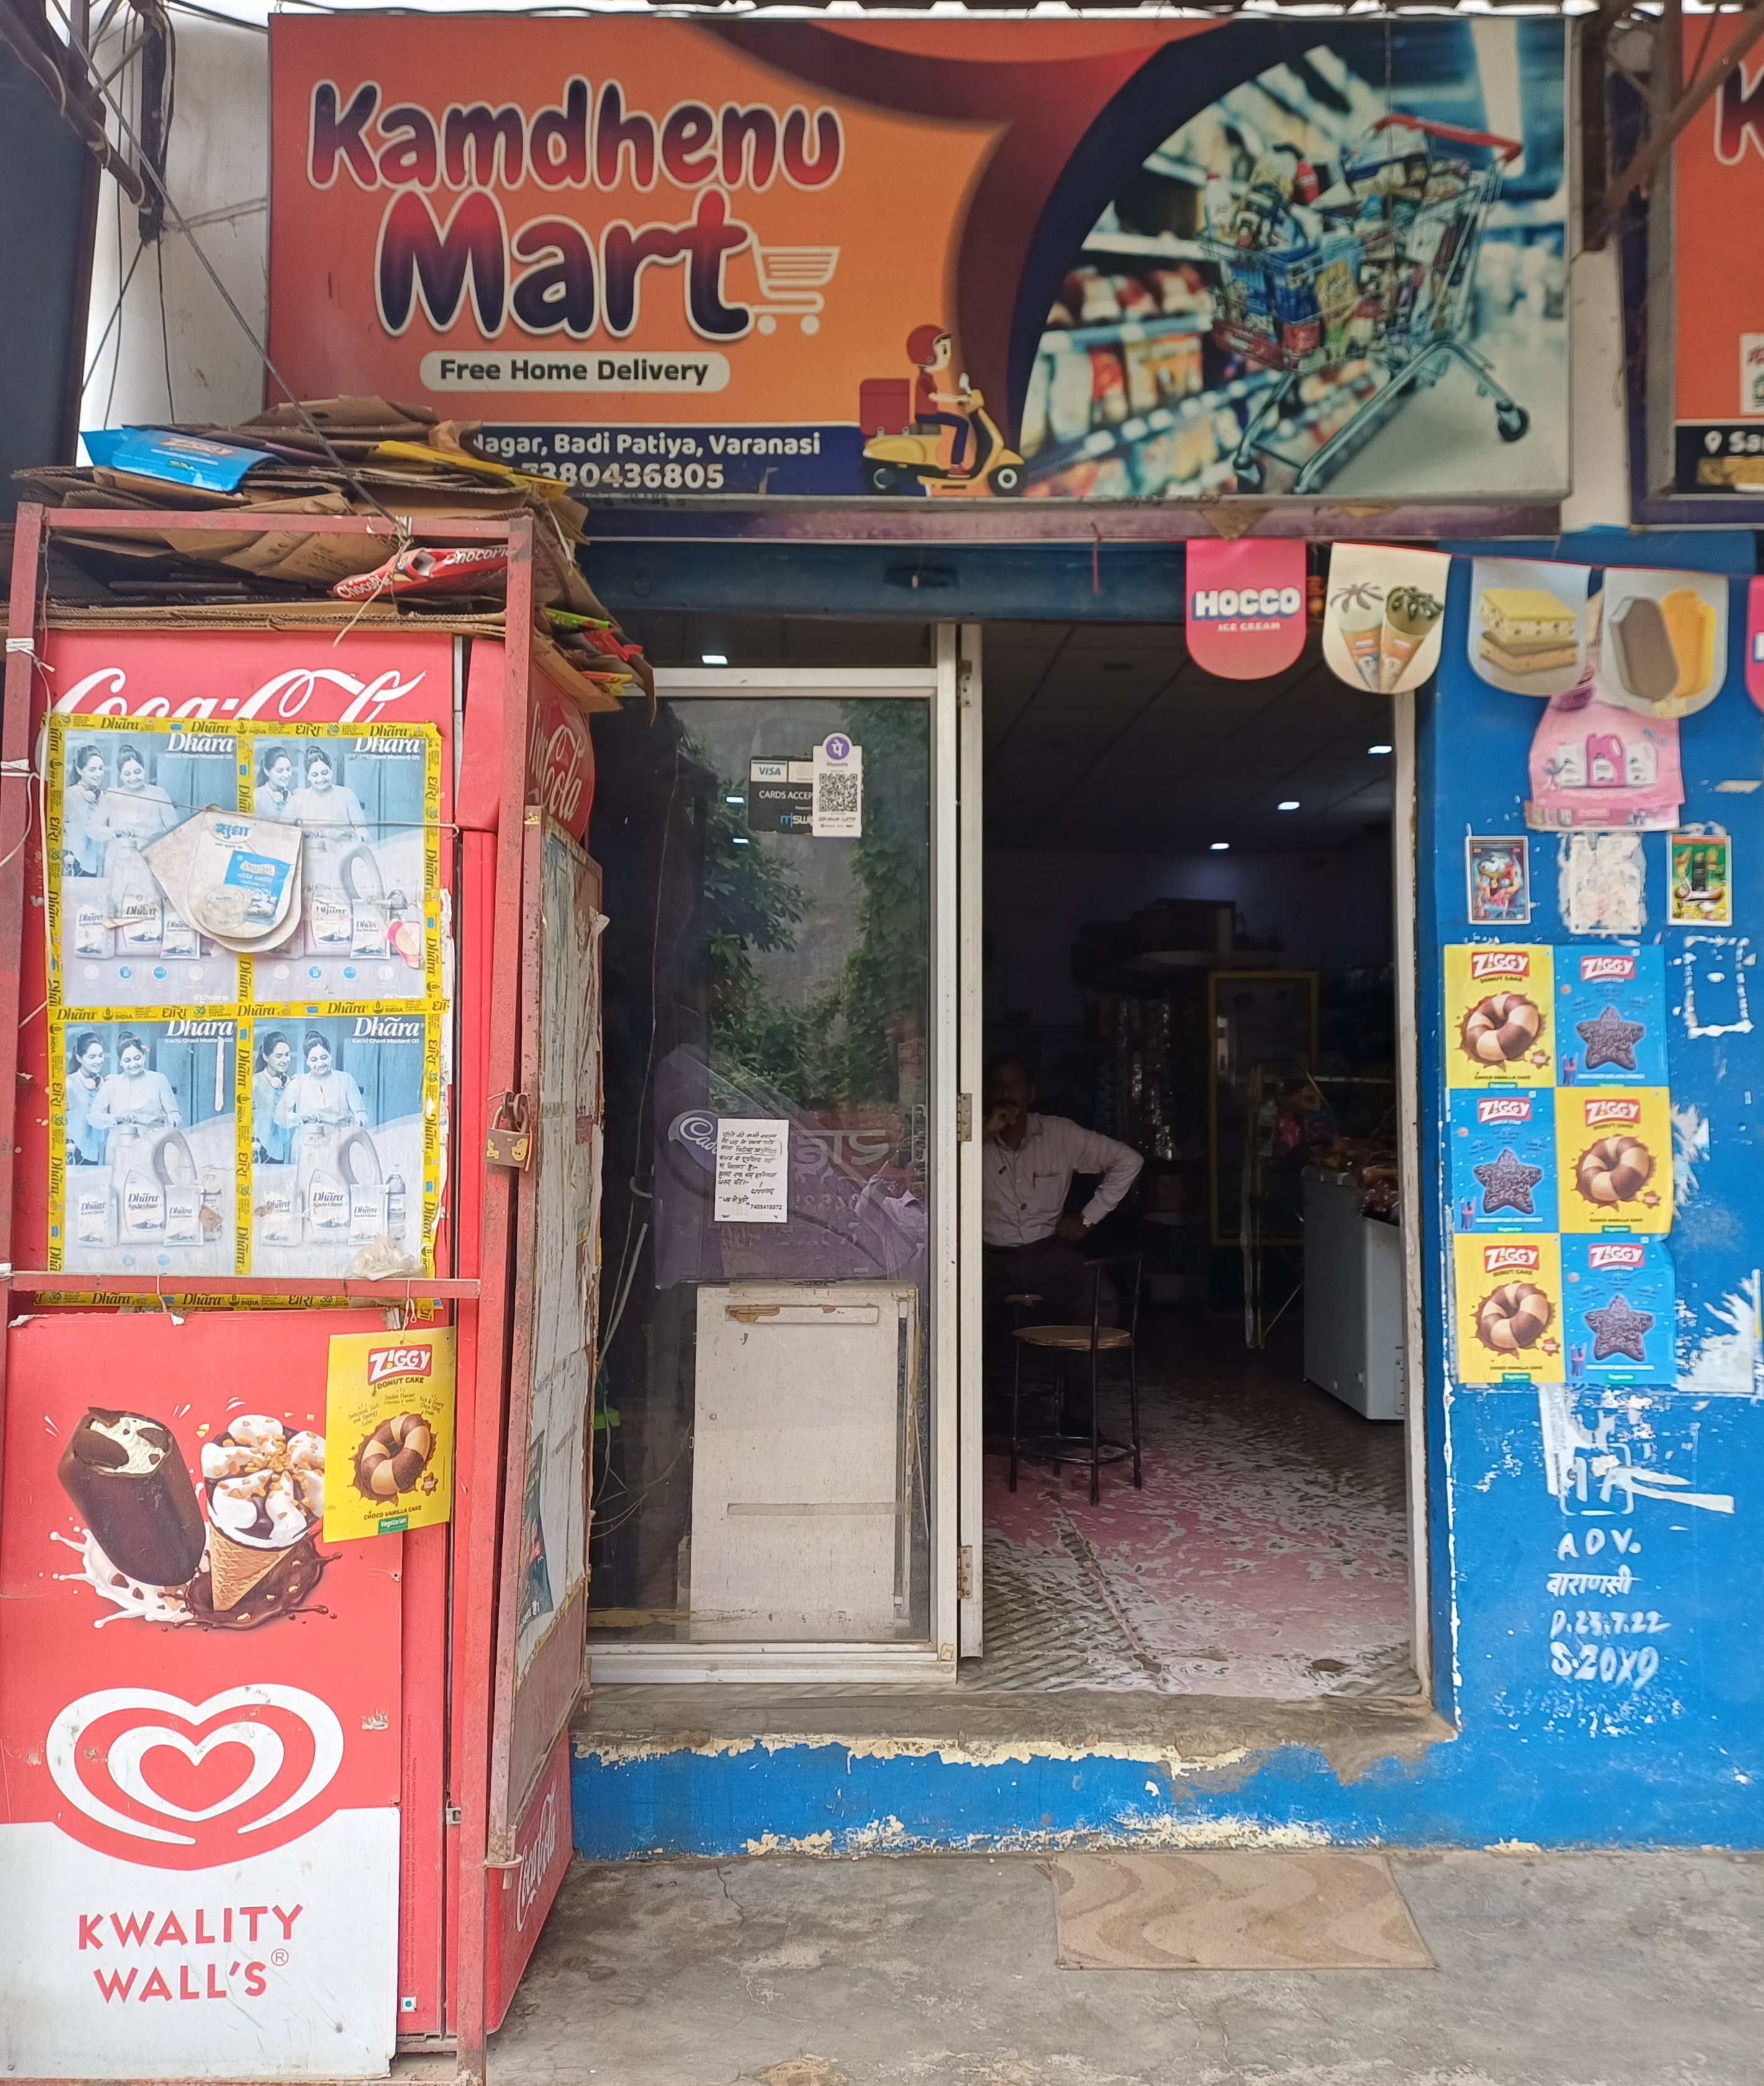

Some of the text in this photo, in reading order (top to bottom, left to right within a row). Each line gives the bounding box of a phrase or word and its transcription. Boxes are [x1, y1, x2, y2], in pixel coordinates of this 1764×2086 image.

[307, 74, 844, 193] Kamdhenu
[374, 184, 754, 341] Mart
[440, 359, 708, 386] Free Home Delivery
[554, 432, 610, 454] Badi
[617, 433, 703, 459] Patiya,
[710, 432, 820, 455] Varanasi
[1192, 586, 1301, 620] HOCCO
[1218, 621, 1281, 632] ICE CREAM
[759, 767, 780, 775] VISA
[759, 790, 786, 799] CARDS
[1473, 953, 1528, 978] ZIGGY
[1583, 958, 1634, 979] ZIGGY
[1479, 1099, 1530, 1123] ZIGGY
[1586, 1100, 1640, 1125] ZIGGY
[1486, 1247, 1538, 1271] ZIGGY
[1590, 1245, 1644, 1268] ZIGGY
[369, 1348, 431, 1383] ZIGGY
[378, 1378, 403, 1389] DONUT
[381, 1518, 406, 1528] Vegetarian
[385, 1509, 407, 1517] VANILLA
[1546, 1564, 1643, 1597] वाराणसी
[78, 1903, 303, 1951] KWALITY
[94, 1961, 267, 2004] WALL'S
